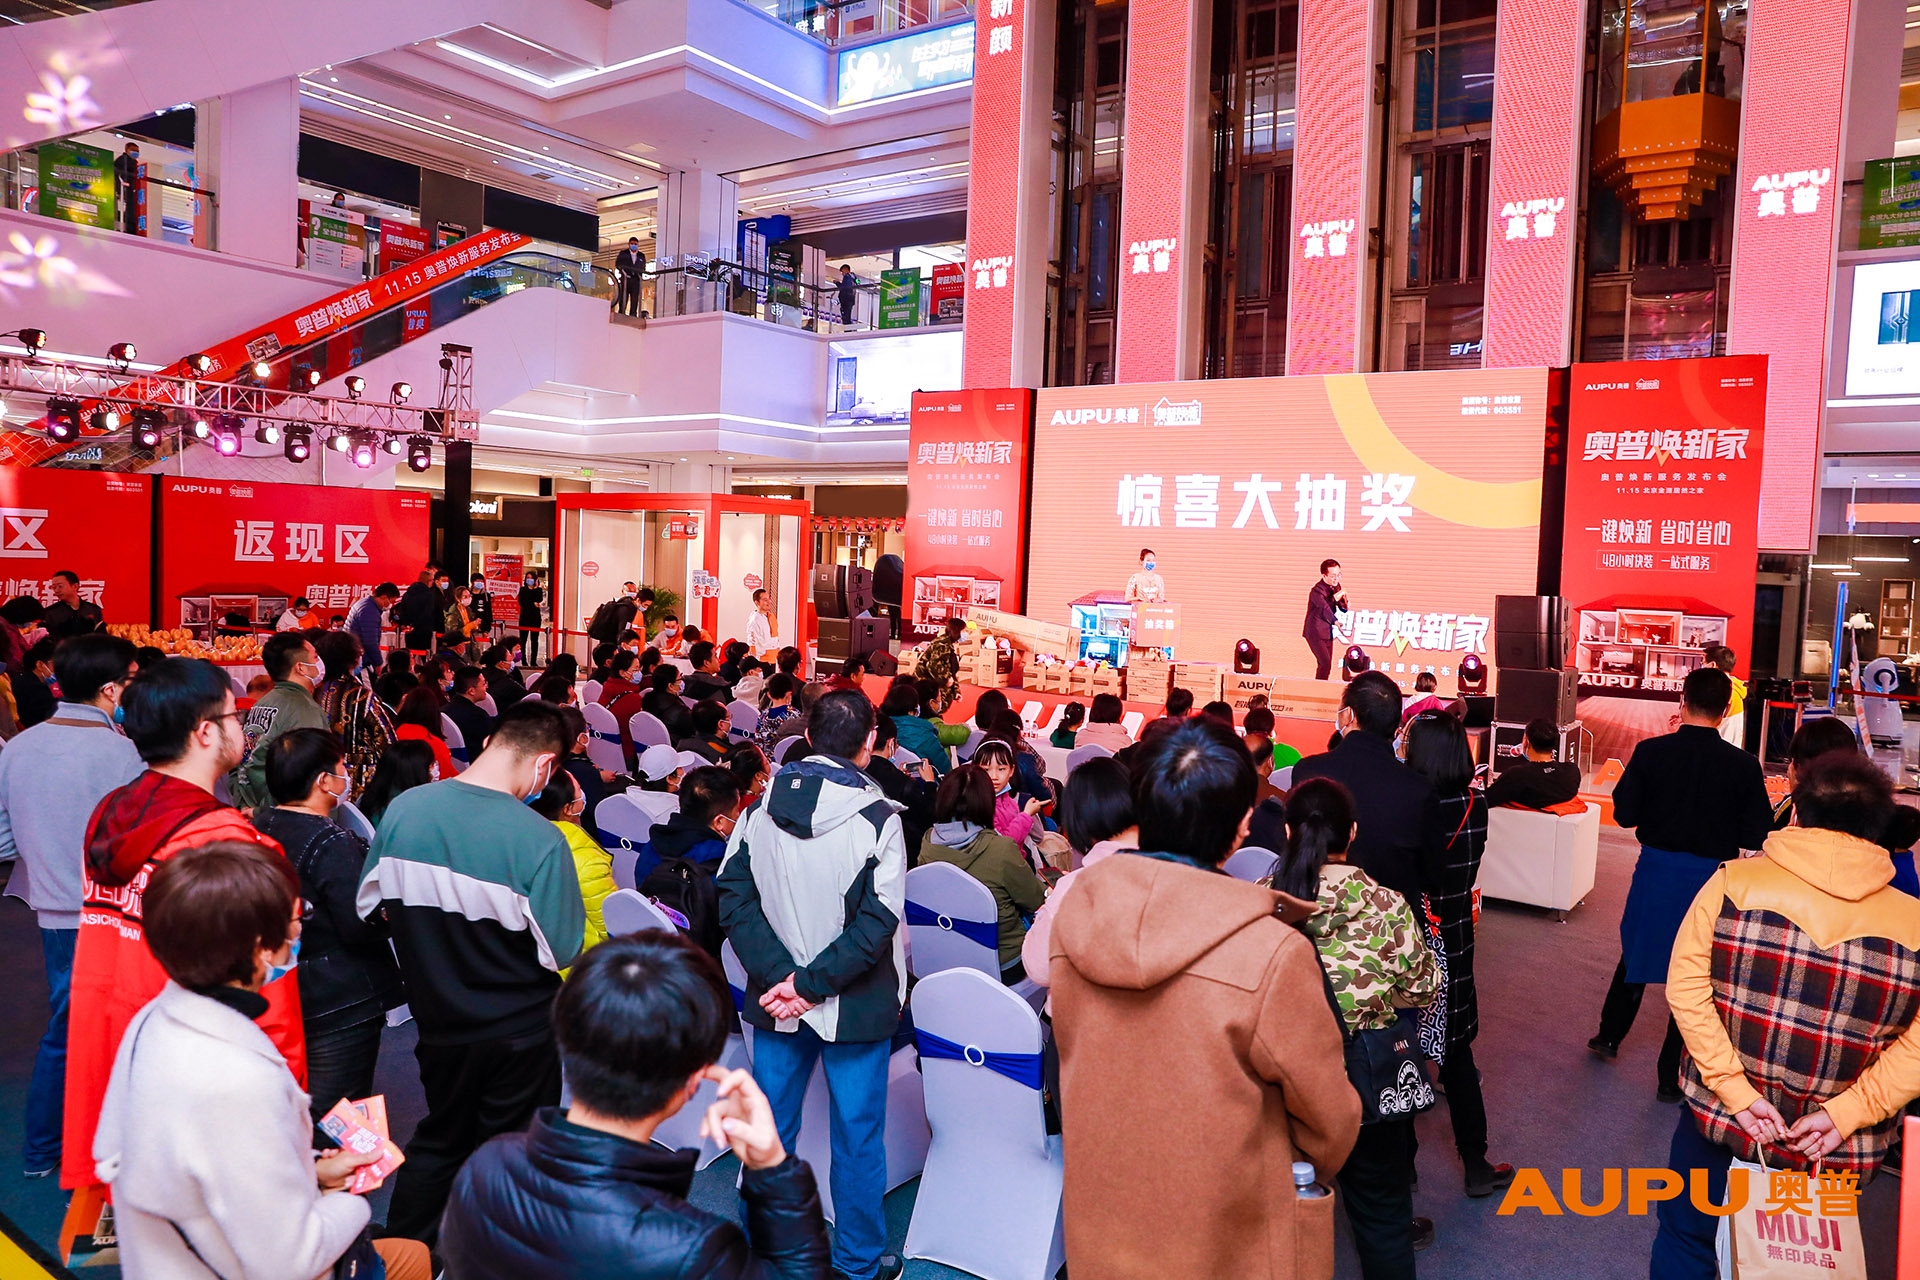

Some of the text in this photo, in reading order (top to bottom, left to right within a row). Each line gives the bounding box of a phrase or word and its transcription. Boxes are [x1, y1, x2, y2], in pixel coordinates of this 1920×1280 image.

[1751, 168, 1831, 192] AUPU
[1500, 197, 1565, 217] AUPU
[1300, 218, 1355, 237] AUPU
[1128, 238, 1177, 254] AUPU
[972, 256, 1013, 271] AUPU
[295, 231, 523, 337] 奥普焕新家 11.15 奥普焕新服务发布会
[1584, 383, 1617, 391] AUPU
[1050, 407, 1112, 426] AUPU
[1115, 406, 1139, 423] 奥普
[916, 441, 1013, 465] 奥普焕新家
[1582, 428, 1750, 462] 奥普焕新家
[1601, 472, 1728, 482] 奥普焕新服务发布会
[172, 484, 208, 493] AUPU
[1116, 473, 1416, 533] 惊喜大抽奖
[918, 508, 958, 527] 一键焕新
[0, 507, 49, 559] 区
[1585, 518, 1731, 546] 一键焕新 省时省心
[234, 520, 370, 564] 返现区
[1602, 553, 1710, 571] 48小时快装 一站式服务
[976, 613, 997, 624] AUPU
[914, 625, 940, 635] AUP
[1238, 681, 1275, 691] AUPU
[1578, 675, 1635, 689] AUPU
[1755, 1209, 1843, 1252] MUJI
[1766, 1243, 1836, 1270] 無印良品
